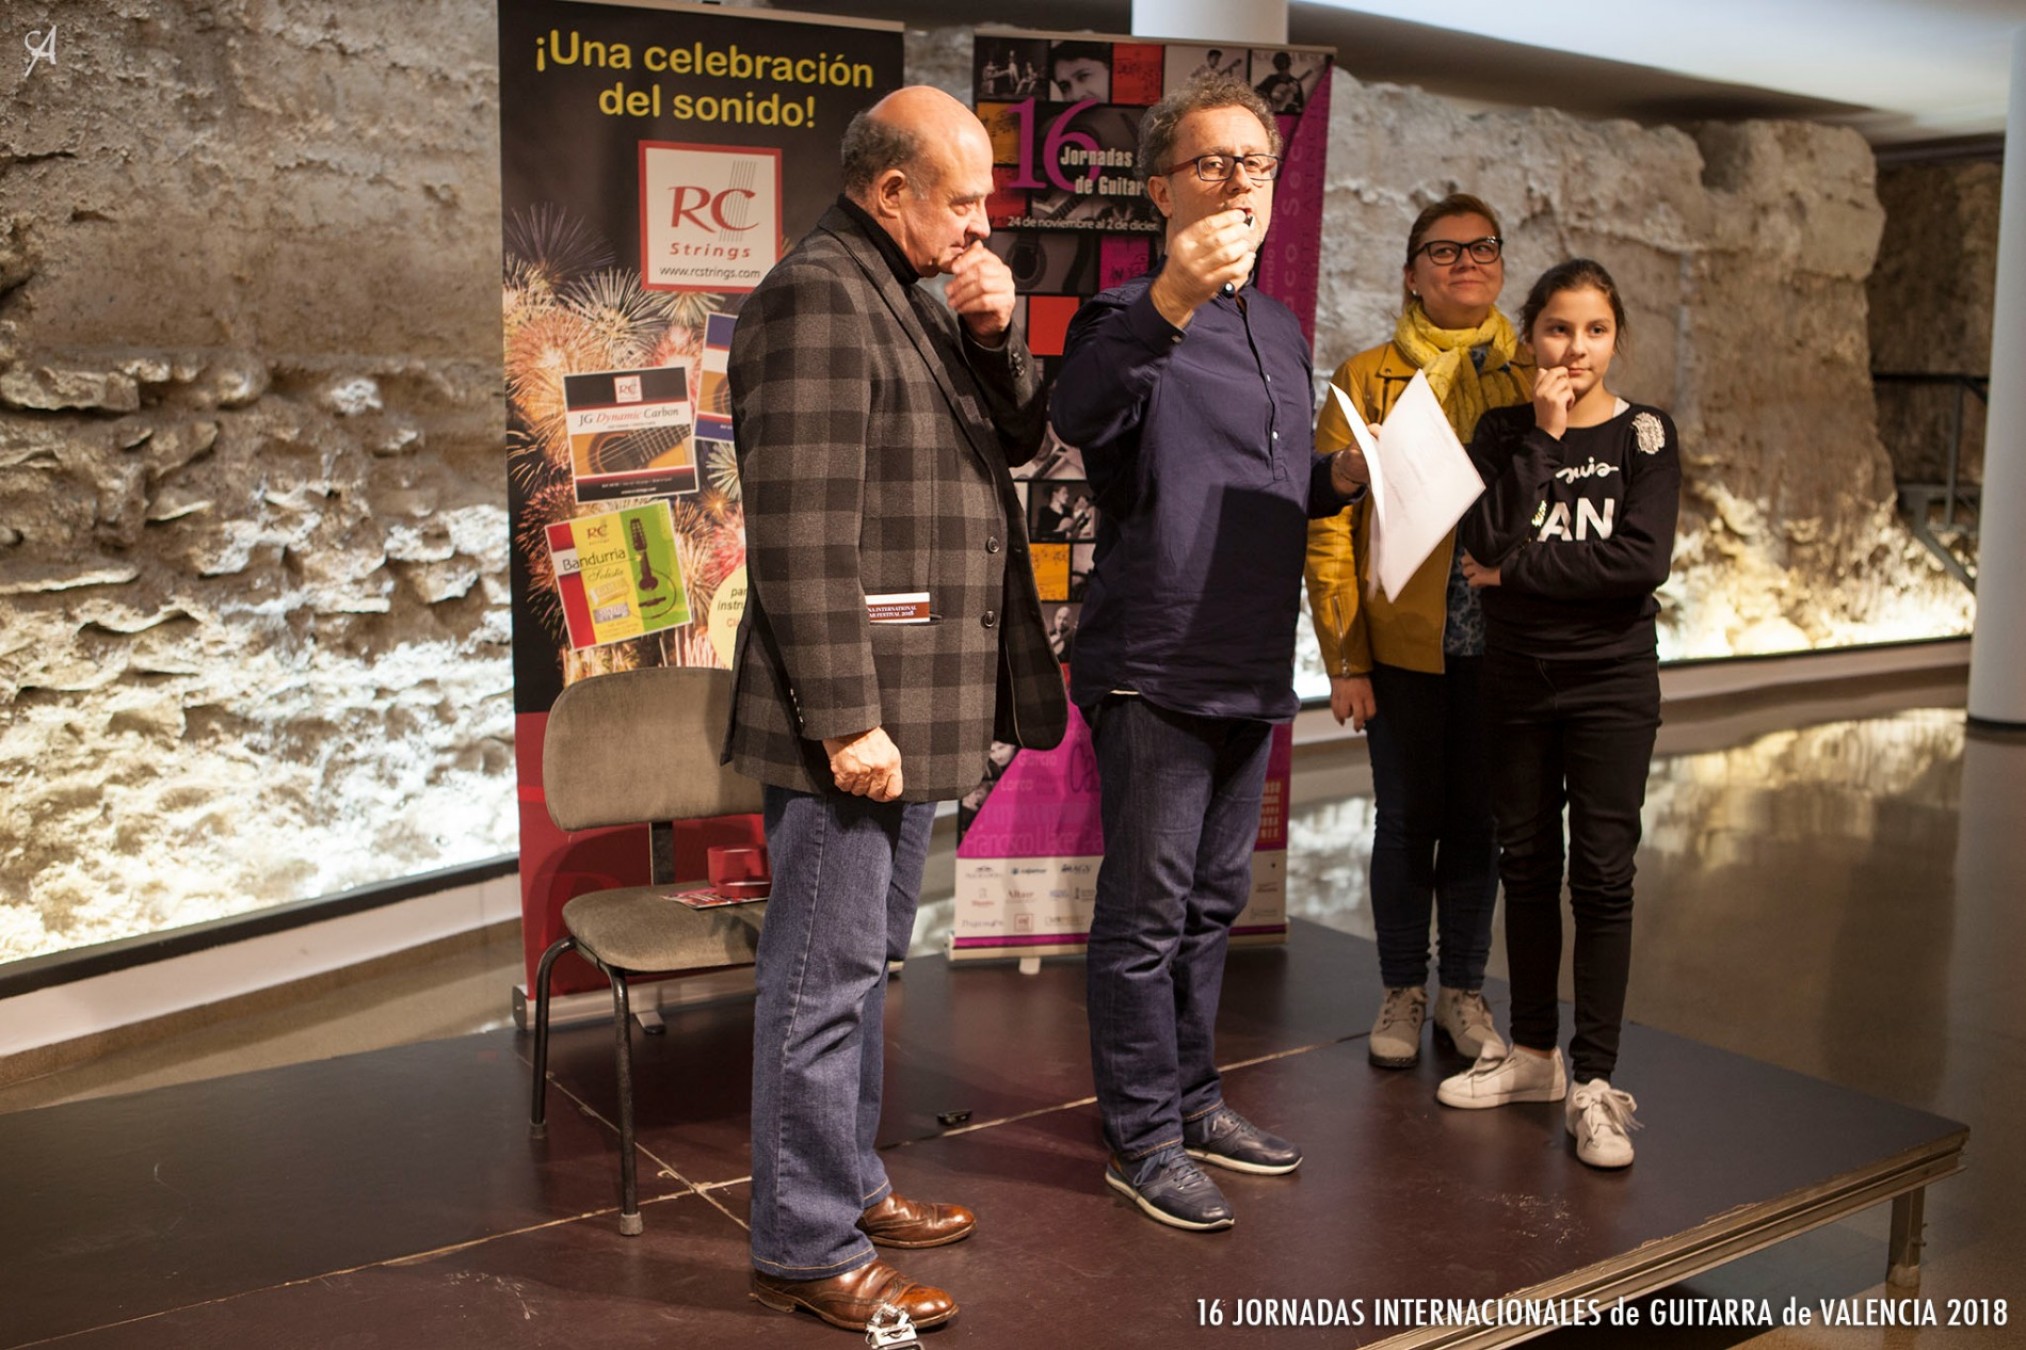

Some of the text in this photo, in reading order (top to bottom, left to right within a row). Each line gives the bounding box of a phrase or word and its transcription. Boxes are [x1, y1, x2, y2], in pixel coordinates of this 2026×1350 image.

[535, 28, 874, 89] ¡Una celebración
[599, 81, 816, 129] del sonido!
[1007, 96, 1100, 192] 16
[1060, 146, 1133, 167] Jornadas
[1075, 176, 1093, 194] de
[667, 185, 760, 233] RC
[1007, 216, 1021, 227] 24
[1022, 217, 1037, 228] de
[1038, 217, 1094, 229] noviembre
[1095, 218, 1105, 229] al
[1106, 219, 1113, 229] 2
[1114, 219, 1128, 230] de
[669, 242, 752, 262] Strings
[659, 264, 761, 280] www.rcstrings.com
[618, 383, 637, 395] RC
[579, 414, 593, 427] JG
[596, 411, 641, 425] Dynamic
[643, 407, 679, 419] Carbon
[587, 524, 608, 539] RC
[562, 548, 627, 571] Bandurria
